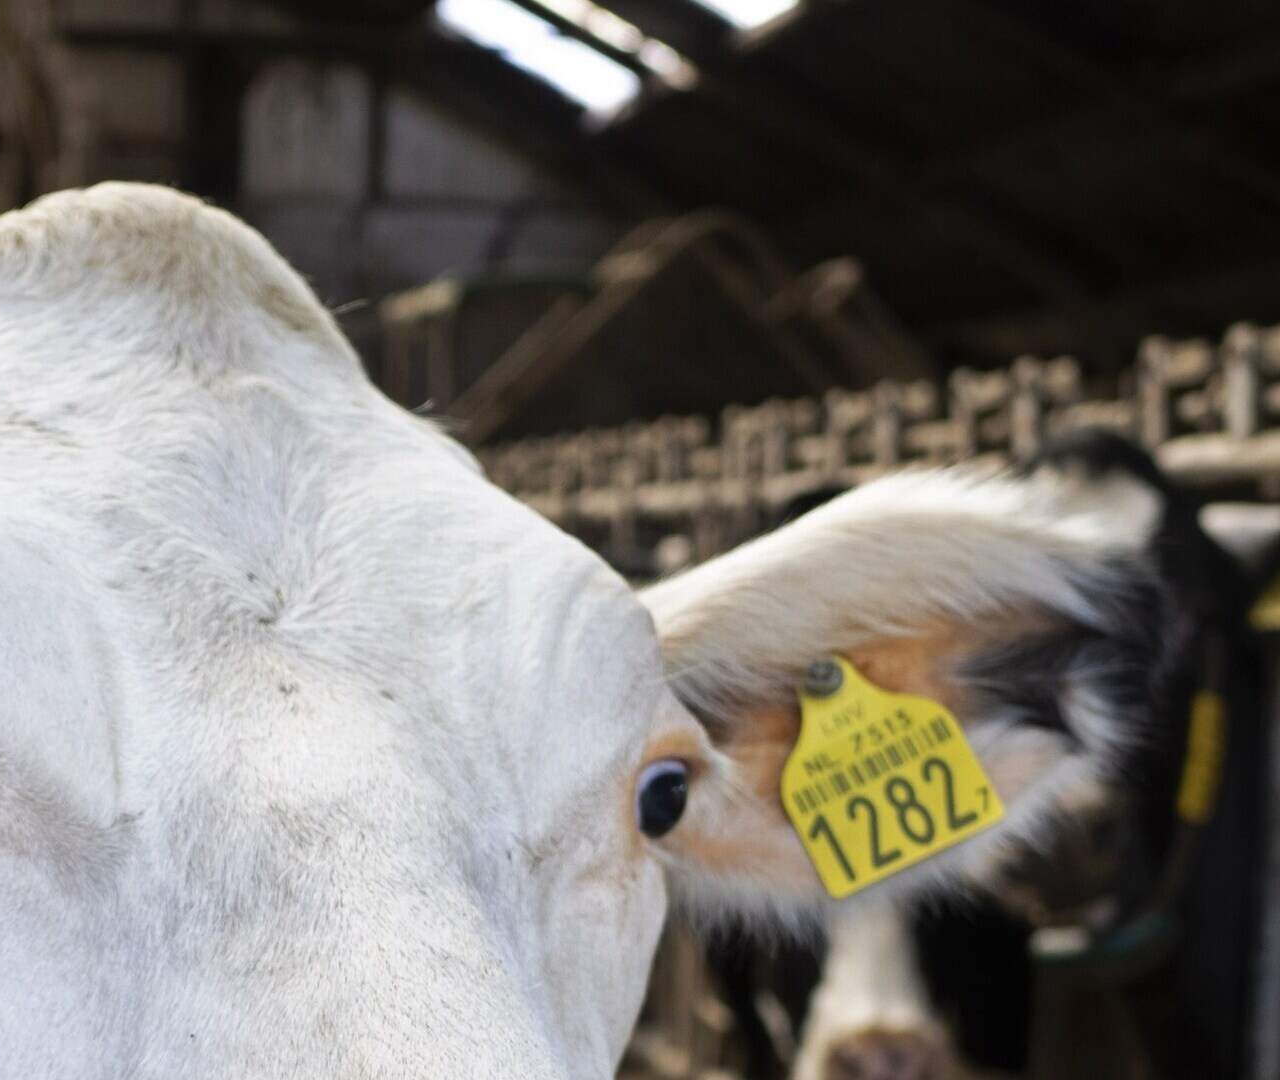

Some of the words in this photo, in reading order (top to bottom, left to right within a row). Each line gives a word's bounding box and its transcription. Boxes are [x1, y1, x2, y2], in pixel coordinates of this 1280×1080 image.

[802, 751, 839, 777] NL
[808, 757, 979, 882] 1282
[976, 786, 990, 812] 7
